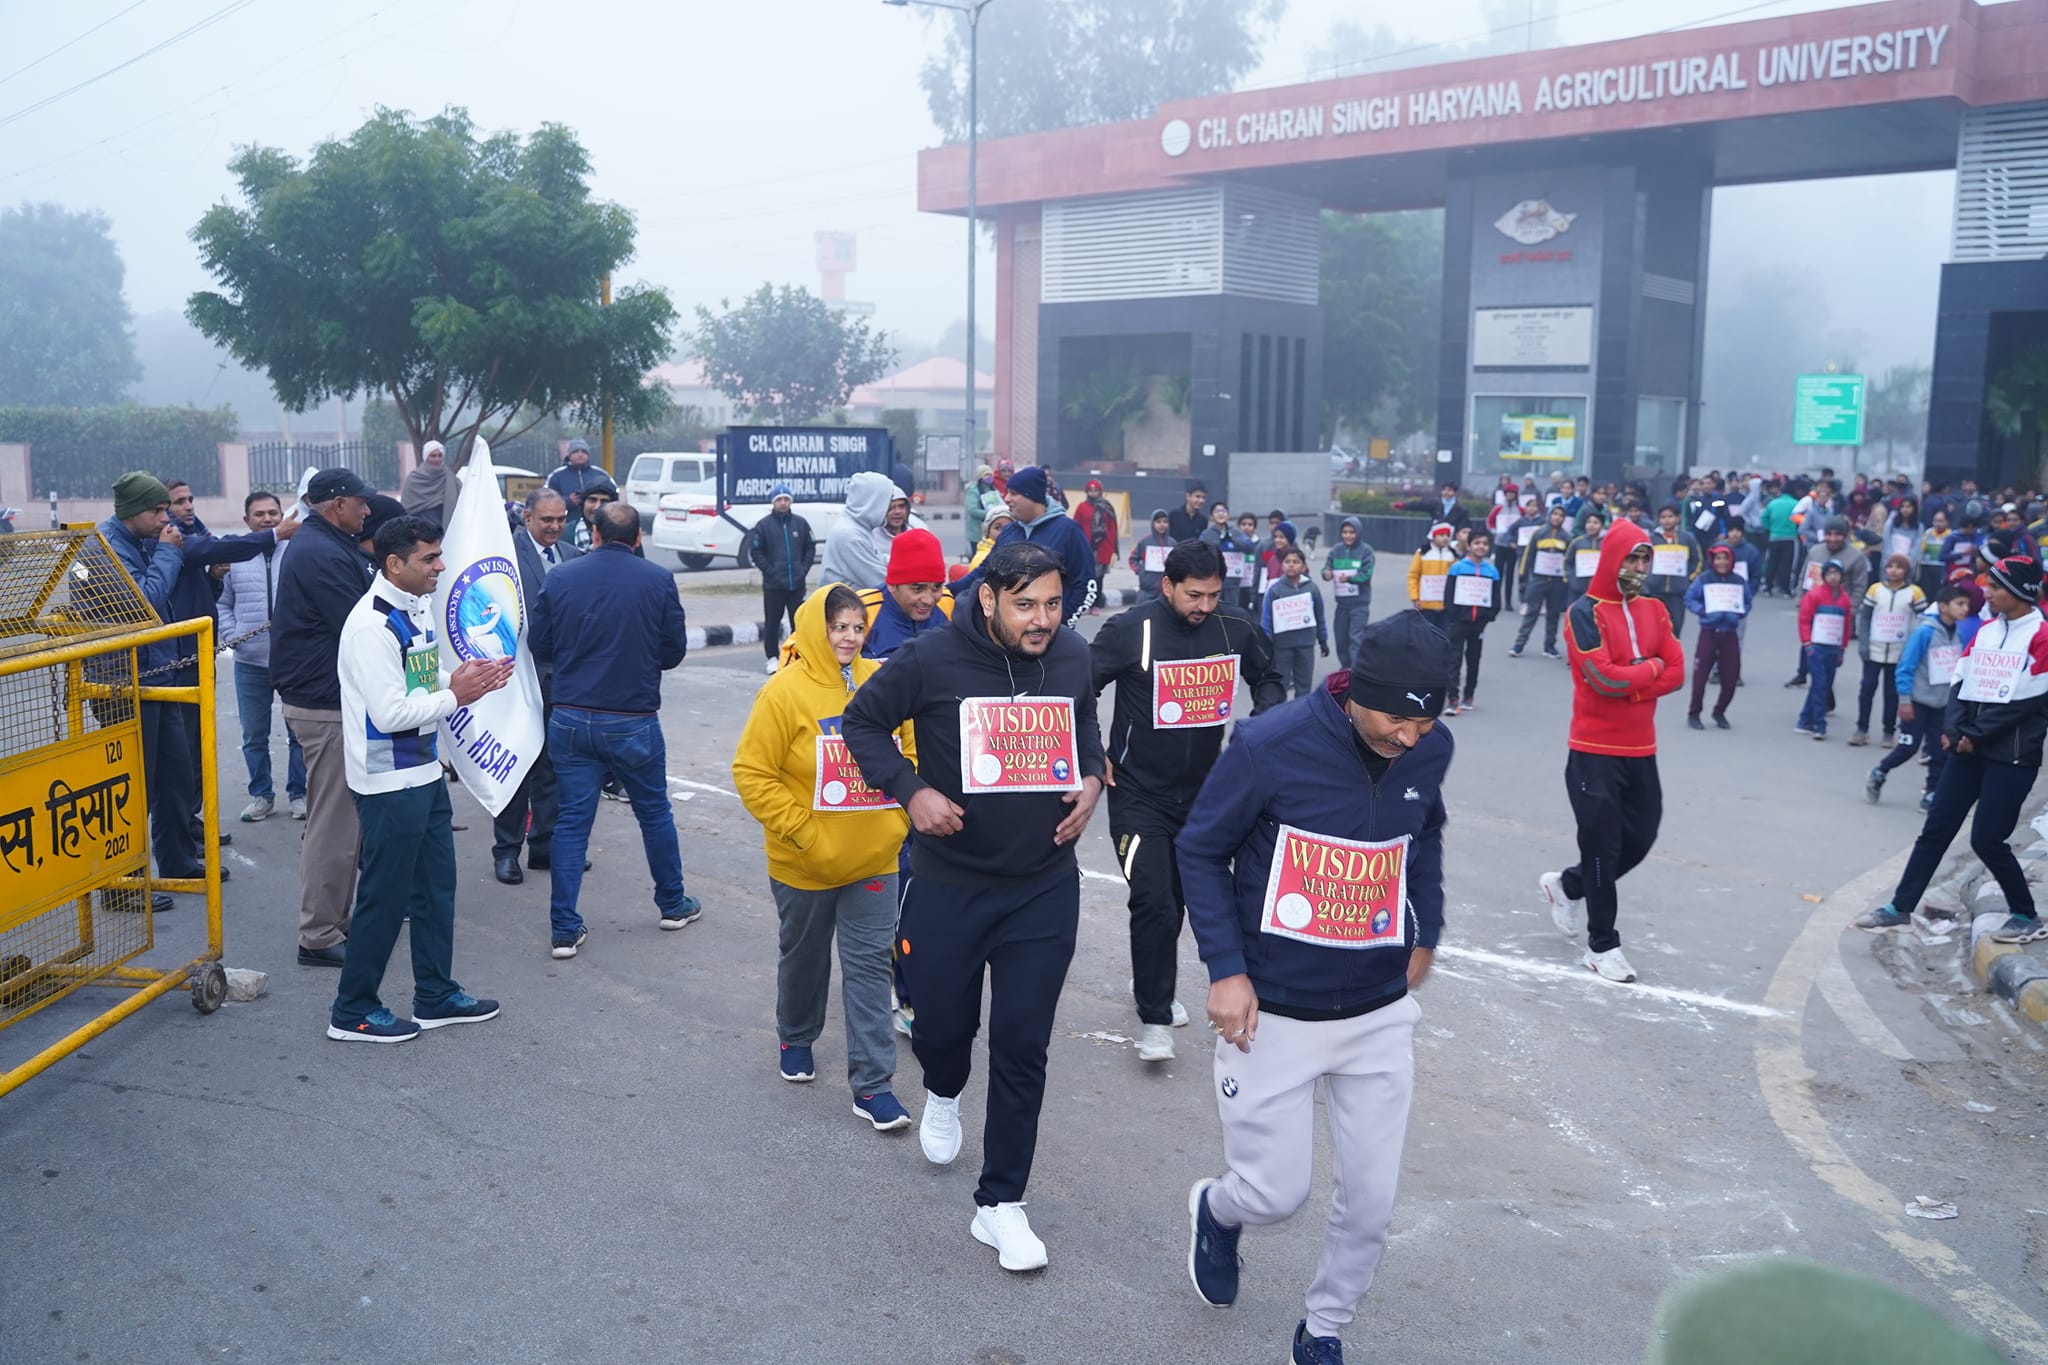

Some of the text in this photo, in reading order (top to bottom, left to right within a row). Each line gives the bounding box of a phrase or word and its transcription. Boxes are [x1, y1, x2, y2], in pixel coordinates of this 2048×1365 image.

[1198, 24, 1949, 149] CH. CHARAN SINGH HARYANA AGRICULTURAL UNIVERSITY
[830, 436, 867, 453] SINGH
[776, 457, 836, 474] HARYANA
[820, 478, 849, 495] UNIVE
[448, 588, 475, 661] SUCCESS FOLLO
[408, 651, 438, 673] WIS
[1974, 652, 2022, 669] WISDOM
[1160, 662, 1234, 687] WISDOM
[1172, 684, 1224, 699] MARATHON
[1184, 698, 1215, 713] 2022
[970, 705, 1070, 733] WISDOM
[1187, 713, 1215, 722] SENIOR
[105, 740, 123, 765] 120
[824, 742, 858, 764] WI
[988, 735, 1062, 751] MARATHON
[467, 730, 518, 784] HISAR
[1004, 752, 1048, 769] 2022
[1007, 773, 1048, 782] SENIOR
[850, 794, 881, 804] SENIOR
[45, 772, 131, 859] हिसार
[105, 832, 130, 860] 2021
[1288, 837, 1402, 882] WISDOM
[1301, 876, 1387, 901] MARATHON
[1316, 900, 1371, 923] 2022
[1317, 923, 1365, 937] SENIOR
